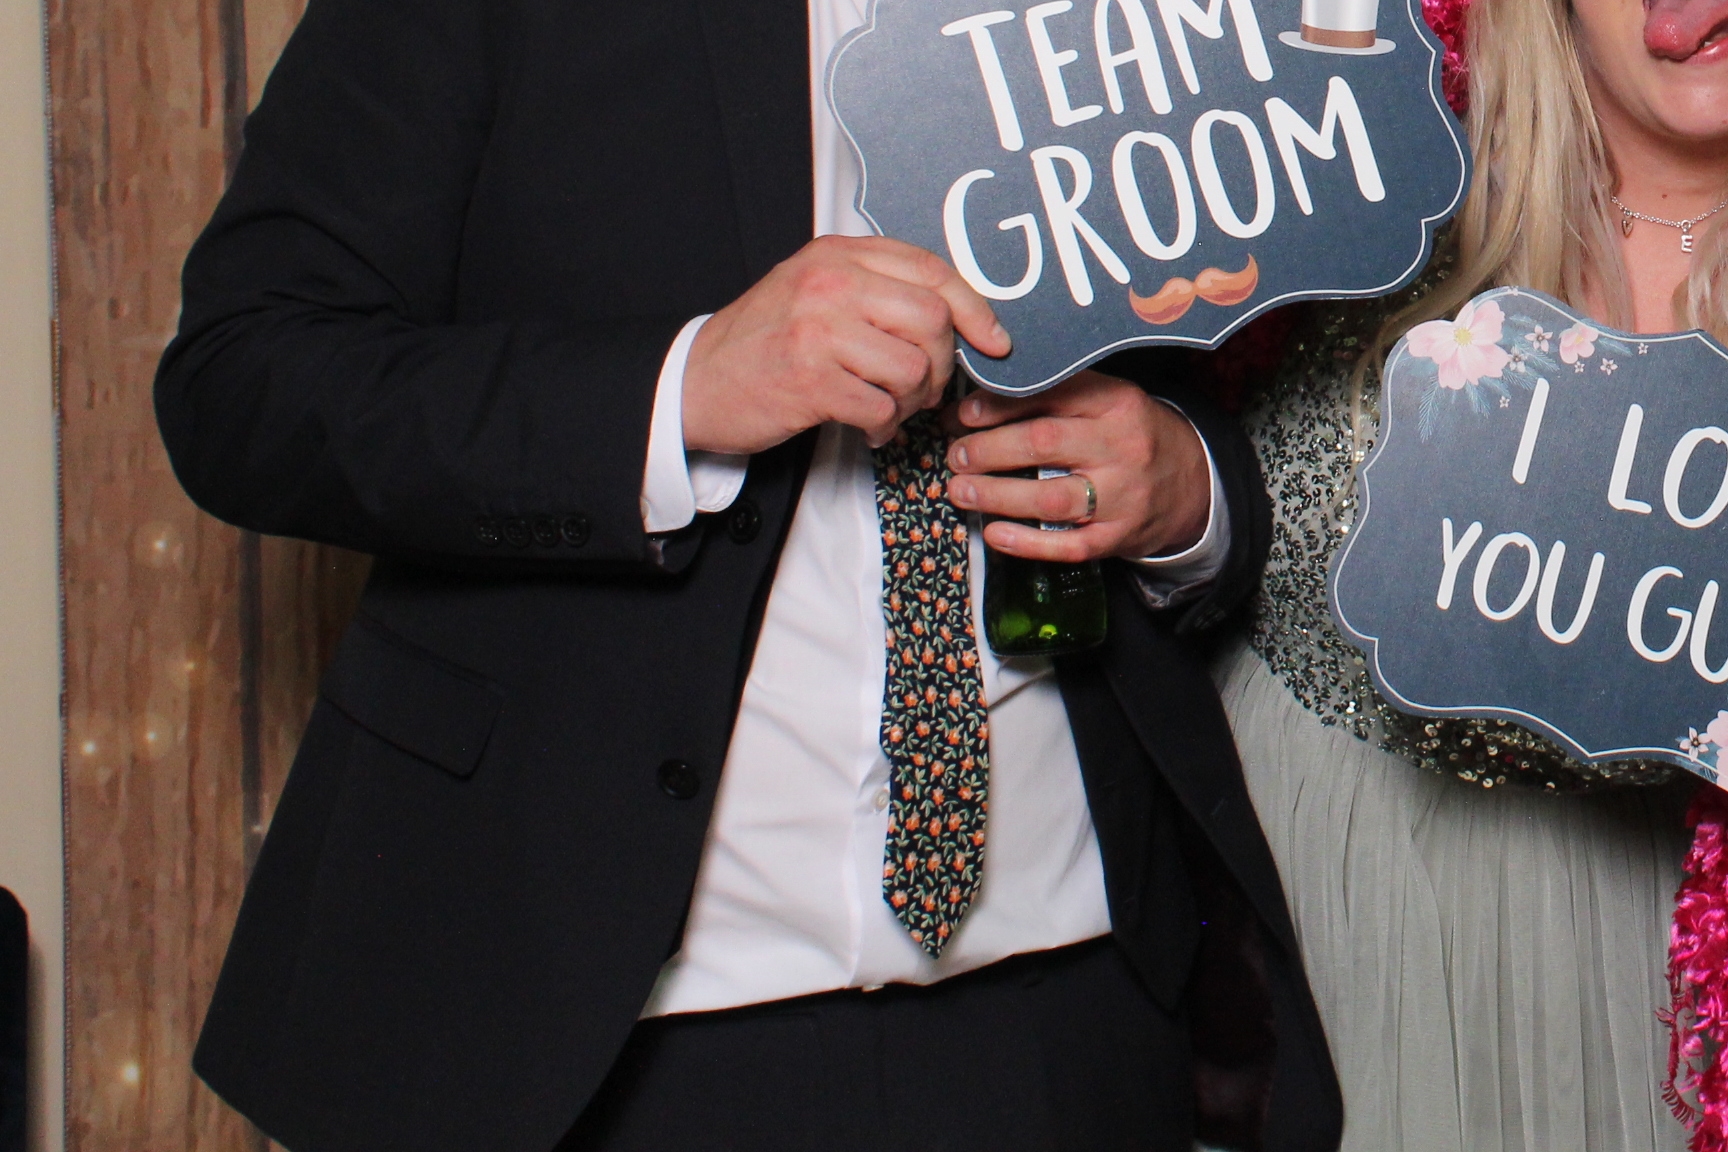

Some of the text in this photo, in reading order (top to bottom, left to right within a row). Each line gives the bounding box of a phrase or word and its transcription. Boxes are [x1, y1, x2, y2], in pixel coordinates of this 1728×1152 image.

[943, 76, 1386, 307] GROOM
[1681, 234, 1693, 253] E
[1511, 377, 1550, 484] I
[1436, 517, 1605, 644] YOU
